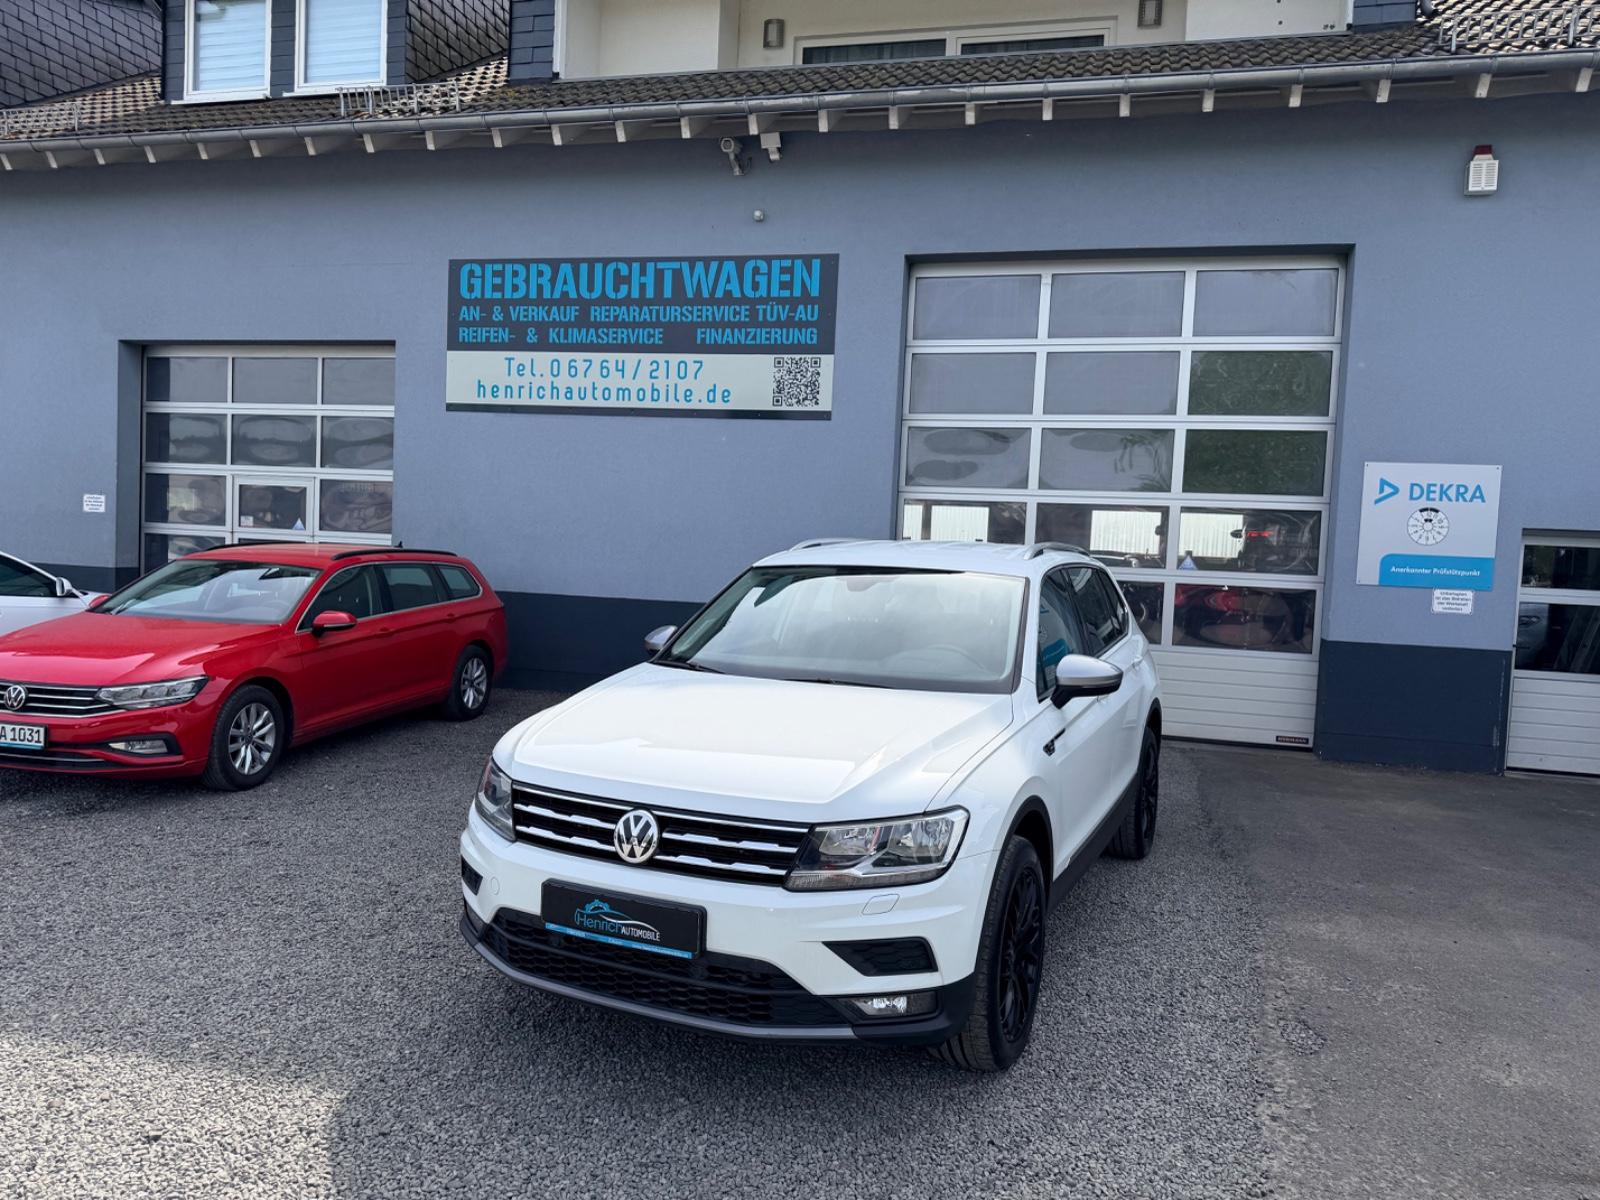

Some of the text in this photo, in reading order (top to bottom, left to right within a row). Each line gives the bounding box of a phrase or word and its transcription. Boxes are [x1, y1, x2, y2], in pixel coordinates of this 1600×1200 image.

[460, 259, 820, 299] GEBRAUCHTWAGEN
[459, 301, 819, 322] AN- & VERKAUF REPARATURSERVICE TÜV-AU
[458, 327, 818, 344] REIFEN- & KLIMASERVICE FINANZIERUNG
[477, 380, 732, 403] henrichautomobile.de
[1408, 482, 1486, 503] DEKRA
[1390, 566, 1432, 574] Anerkannter
[10, 727, 42, 744] 1031
[621, 926, 661, 942] AUTOMOBILE
